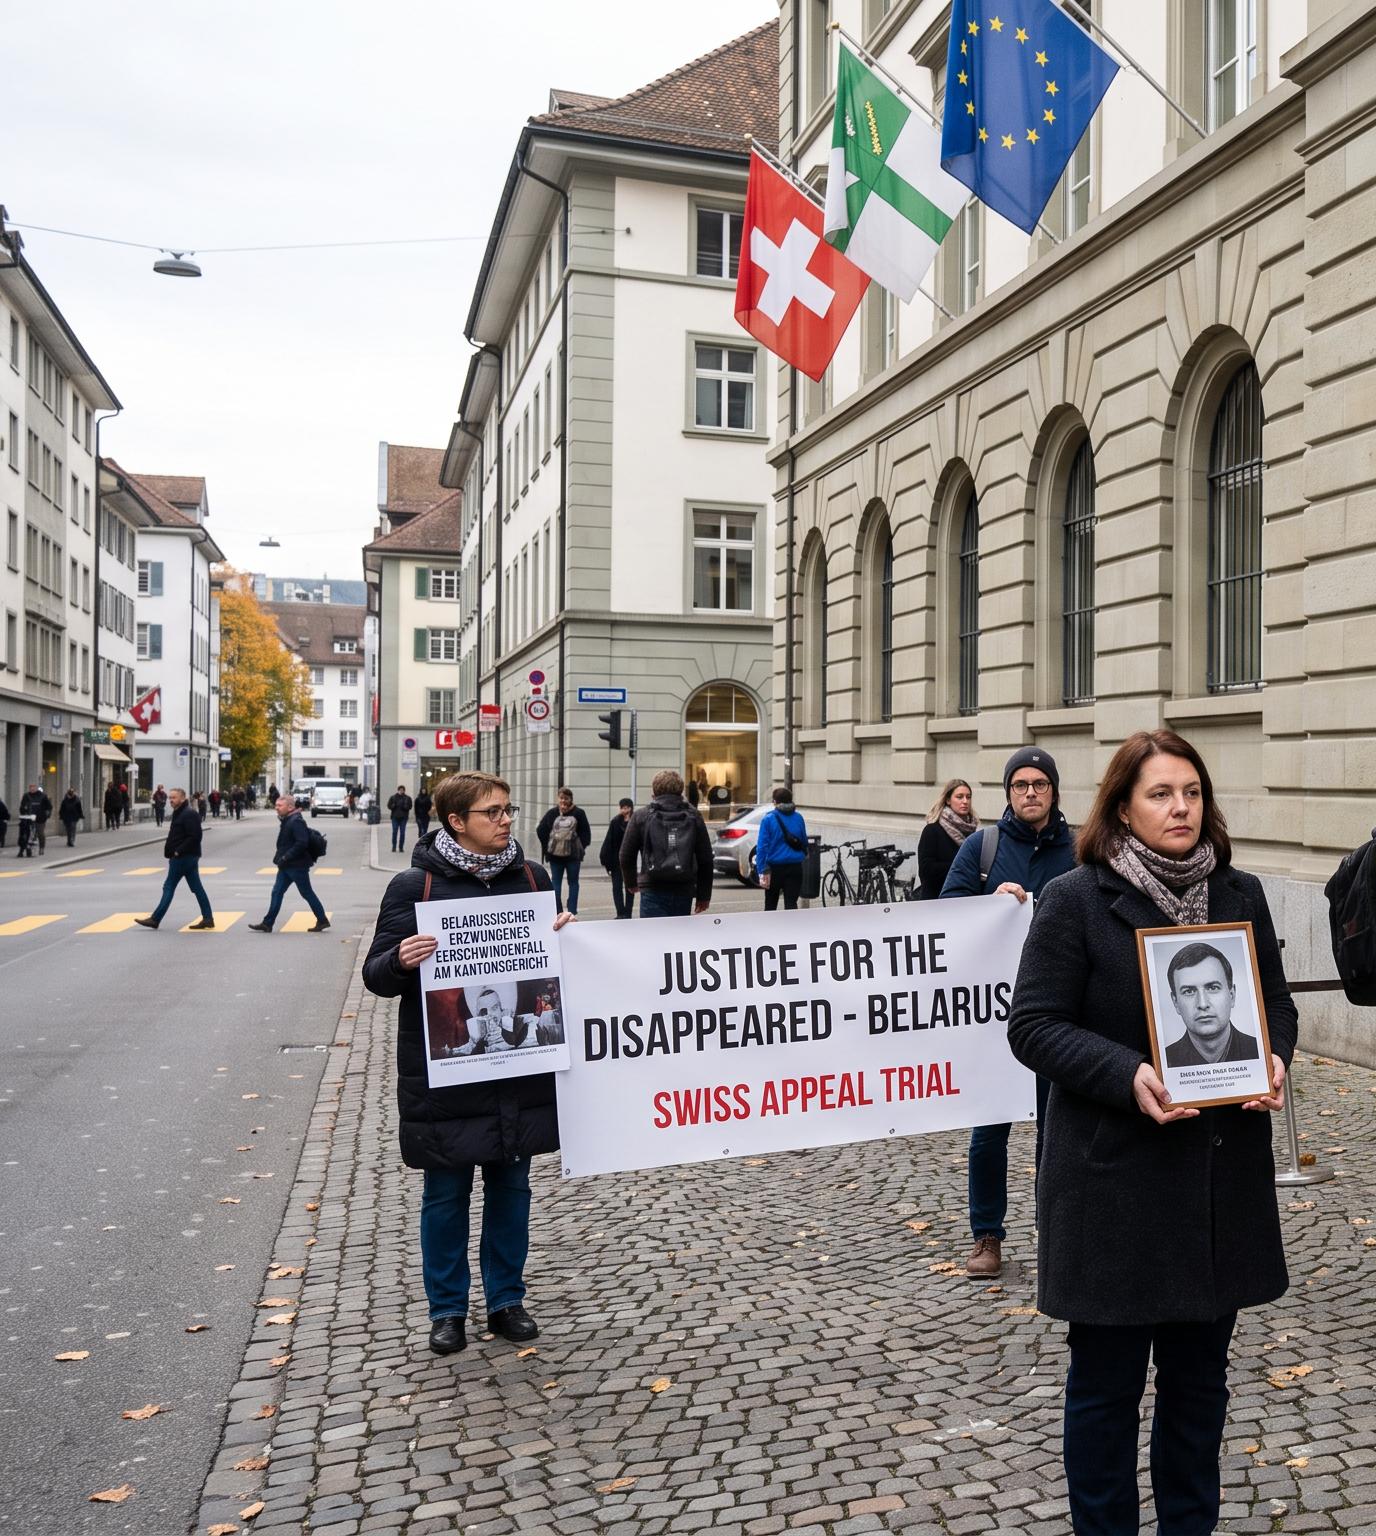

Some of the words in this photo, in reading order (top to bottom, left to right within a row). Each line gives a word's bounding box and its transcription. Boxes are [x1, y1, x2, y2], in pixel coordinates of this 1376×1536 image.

[442, 910, 535, 930] BELARUSSISCHER
[450, 926, 530, 945] ERZWUNGENES
[436, 941, 545, 963] EERSCHWINDENFALL
[434, 963, 451, 979] AM
[455, 956, 548, 977] KANTONSGERICHT
[660, 944, 799, 995] JUSTICE
[810, 939, 874, 983] FOR
[883, 933, 947, 976] THE
[584, 1000, 831, 1061] DISAPPEARED
[868, 982, 1011, 1035] BELARUS
[654, 1084, 750, 1128] SWISS
[761, 1072, 873, 1117] APPEAL
[880, 1062, 960, 1102] TRIAL
